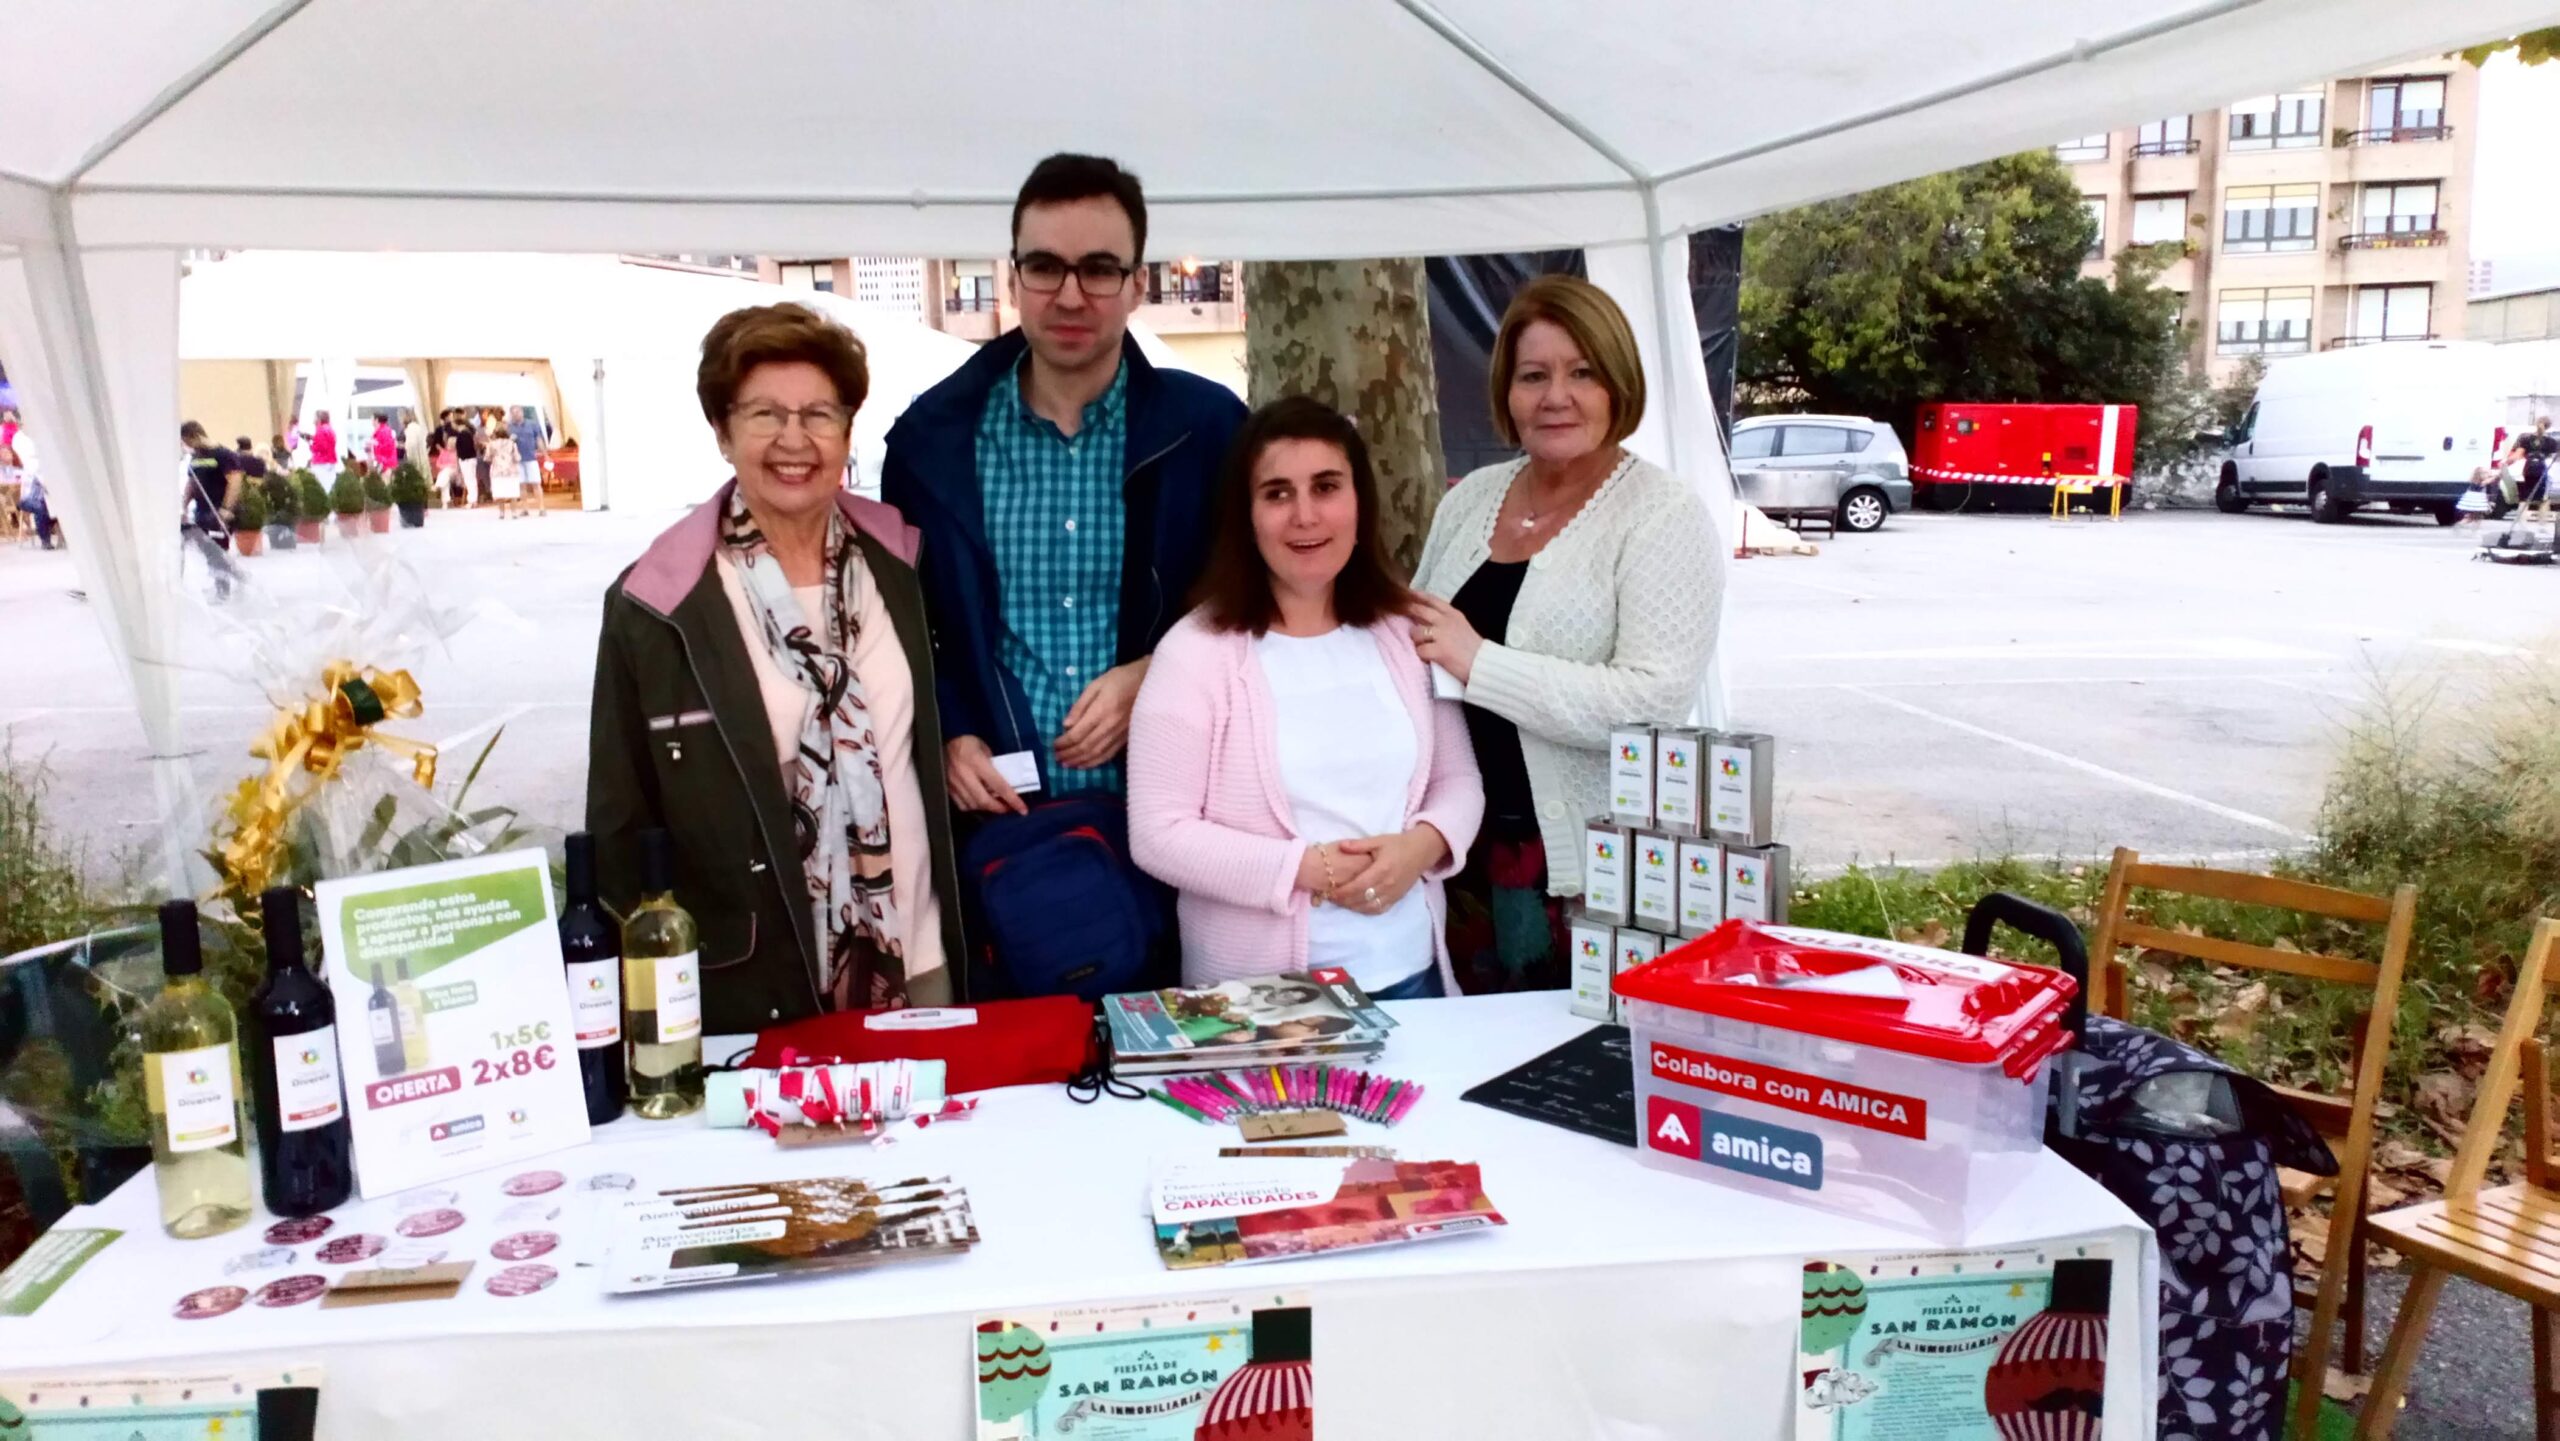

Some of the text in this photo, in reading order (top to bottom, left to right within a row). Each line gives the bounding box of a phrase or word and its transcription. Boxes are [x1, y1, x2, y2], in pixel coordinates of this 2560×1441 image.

[353, 892, 477, 921] Comprando estos
[356, 898, 511, 937] productos, nos ayudas
[369, 927, 418, 947] apoyar
[431, 914, 493, 937] personas
[496, 909, 522, 922] con
[1767, 931, 1981, 974] COLABORA
[489, 1020, 552, 1051] 1x5€
[374, 1043, 557, 1104] OFERTA 2x8€
[1653, 1049, 1908, 1125] Colabora con AMICA
[1711, 1131, 1813, 1177] amica
[1163, 1185, 1292, 1202] Descubriendo
[1165, 1190, 1319, 1211] CAPACIDADES
[1870, 1312, 2017, 1335] SAN RAMÓN
[1921, 1304, 1981, 1316] FIESTAS DE
[1897, 1334, 1999, 1354] LA INMOBILIARIA
[1113, 1360, 1178, 1375] FIESTAS DE
[1058, 1367, 1219, 1399] SAN RAMÓN
[1090, 1391, 1203, 1416] LA INMOBILIARIA
